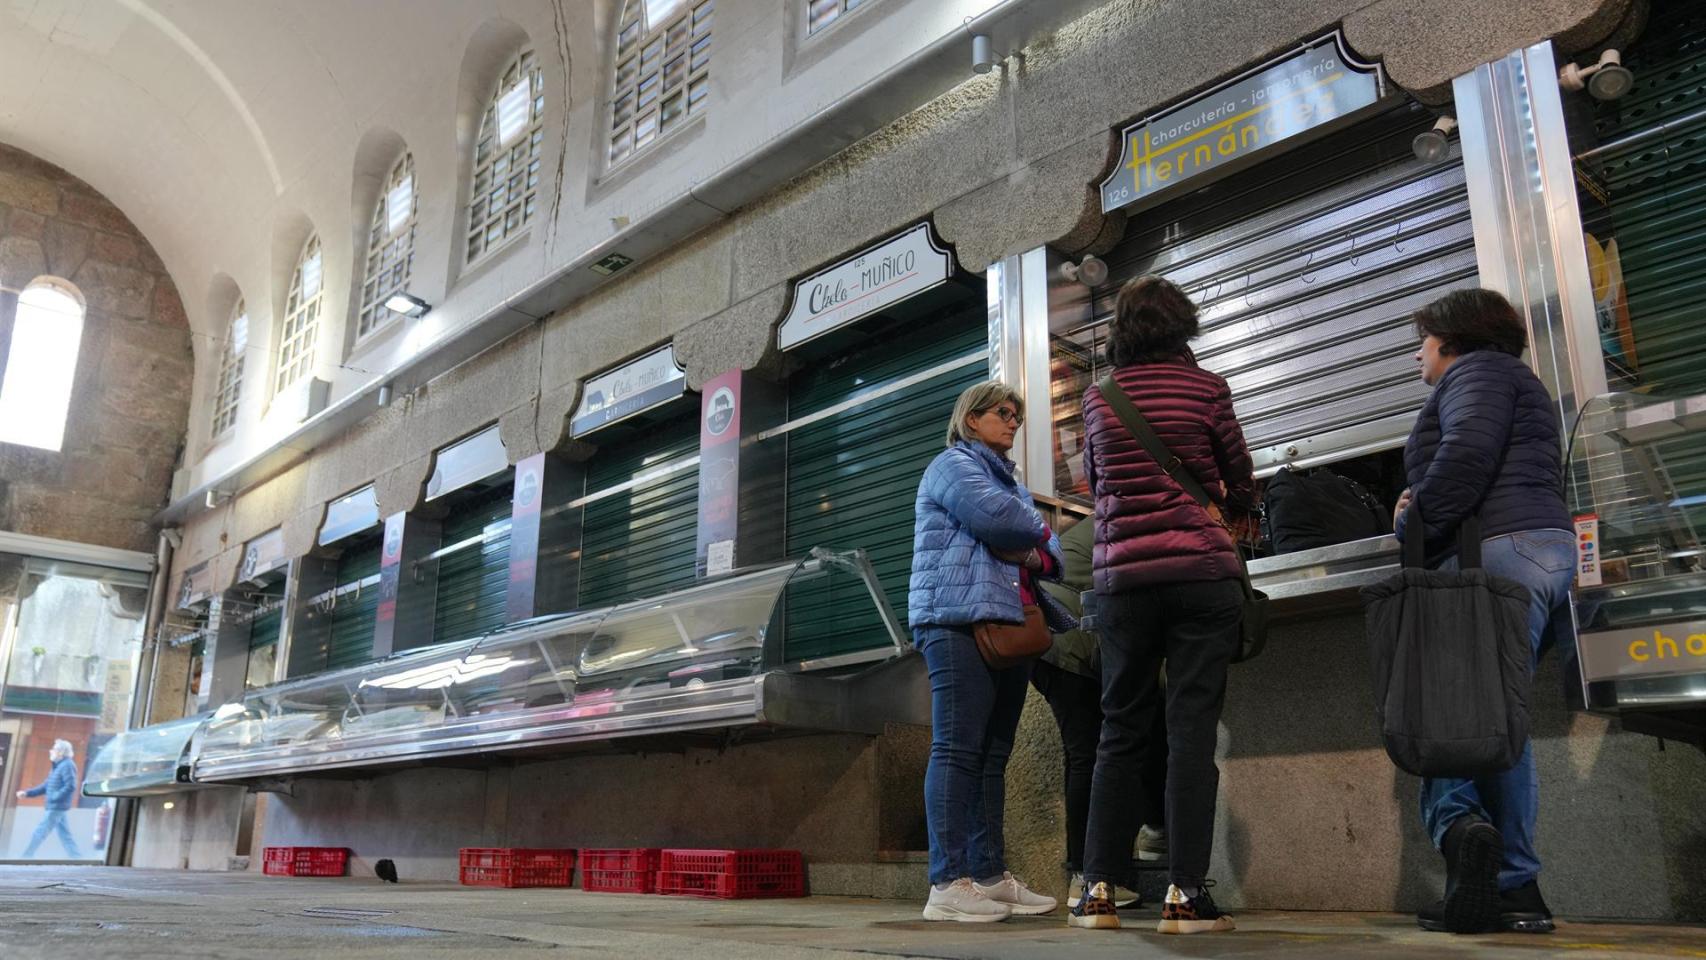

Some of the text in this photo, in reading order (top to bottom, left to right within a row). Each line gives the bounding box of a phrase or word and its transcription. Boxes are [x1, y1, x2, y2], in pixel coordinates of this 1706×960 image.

[1151, 100, 1236, 146] charcutería
[1108, 187, 1129, 203] 126
[854, 257, 866, 269] 125
[809, 279, 848, 315] Chelo
[861, 250, 915, 292] MUÑICO
